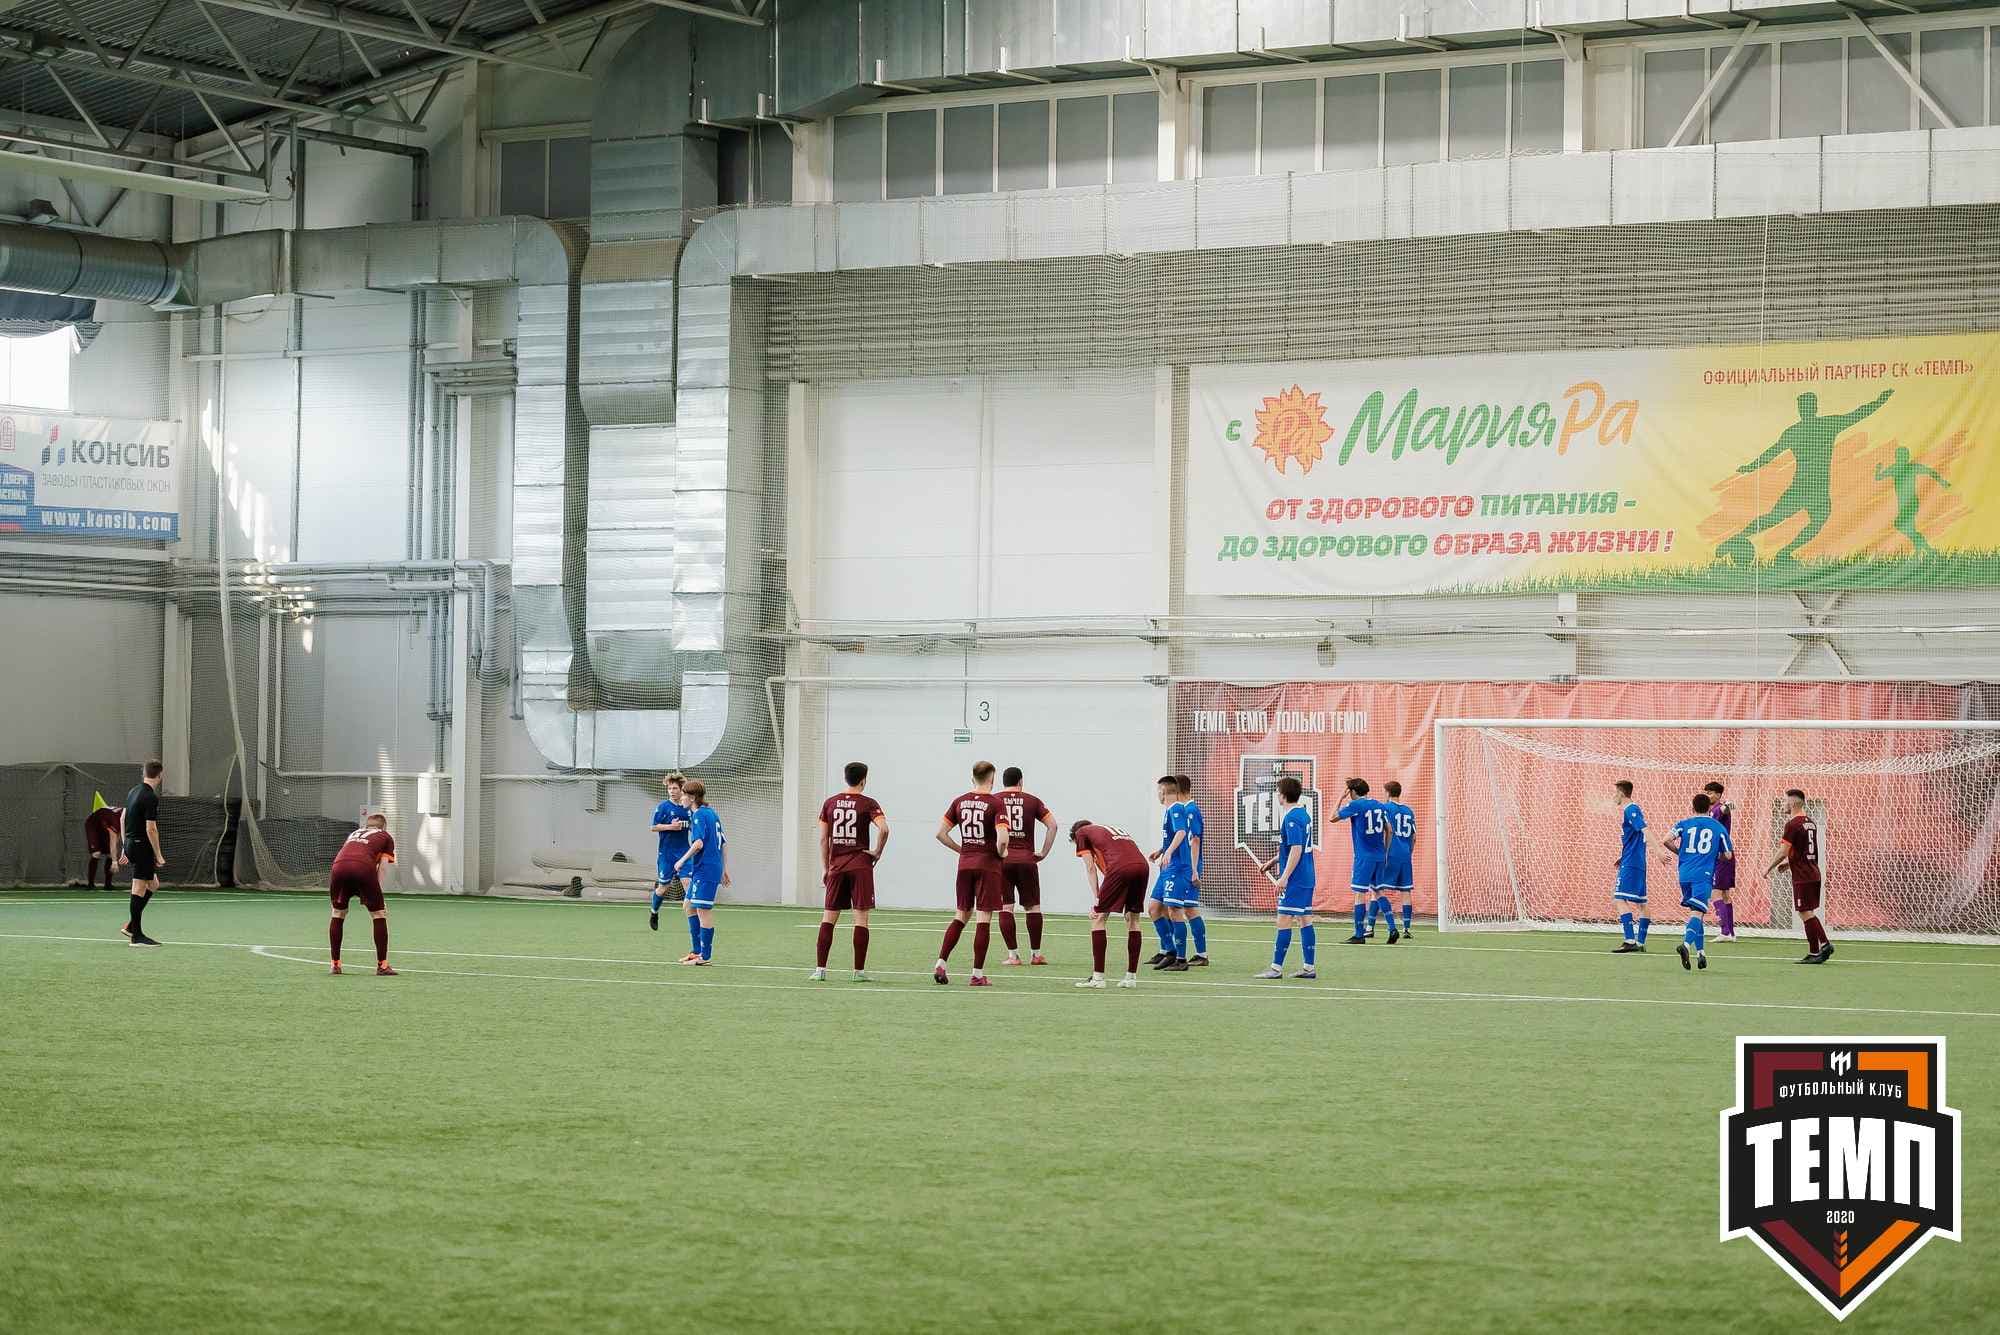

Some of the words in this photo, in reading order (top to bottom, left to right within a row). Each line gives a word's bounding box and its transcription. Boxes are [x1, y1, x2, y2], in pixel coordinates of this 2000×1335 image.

[1703, 362, 1819, 387] ОФИЦИАЛЬНЫЙ
[1824, 363, 1887, 380] ПАРТНЕР
[1891, 362, 1910, 378] СК
[1914, 359, 1975, 376] «ТЕМП»
[71, 440, 170, 468] КОНСИБ
[80, 474, 145, 492] ПЛАСТИКОВЫХ
[147, 478, 171, 493] ОКОН
[1265, 498, 1302, 521] ОТ
[1306, 495, 1474, 524] ЗДОРОВОГО
[1480, 491, 1618, 517] ПИТАНИЯ
[41, 511, 171, 532] www.konsib.com
[1217, 535, 1260, 562] ДО
[1262, 534, 1429, 562] ЗДОРОВОГО
[1433, 531, 1543, 557] ОБРАЗА
[979, 701, 990, 722] 3
[1275, 711, 1326, 734] ТОЛЬКО
[1329, 711, 1368, 734] ТЕМП!
[832, 808, 858, 839] 22
[961, 808, 986, 839] 25
[1006, 805, 1024, 832] 13
[1365, 808, 1384, 835] 13
[1395, 812, 1412, 838] 15
[1685, 826, 1713, 855] 18
